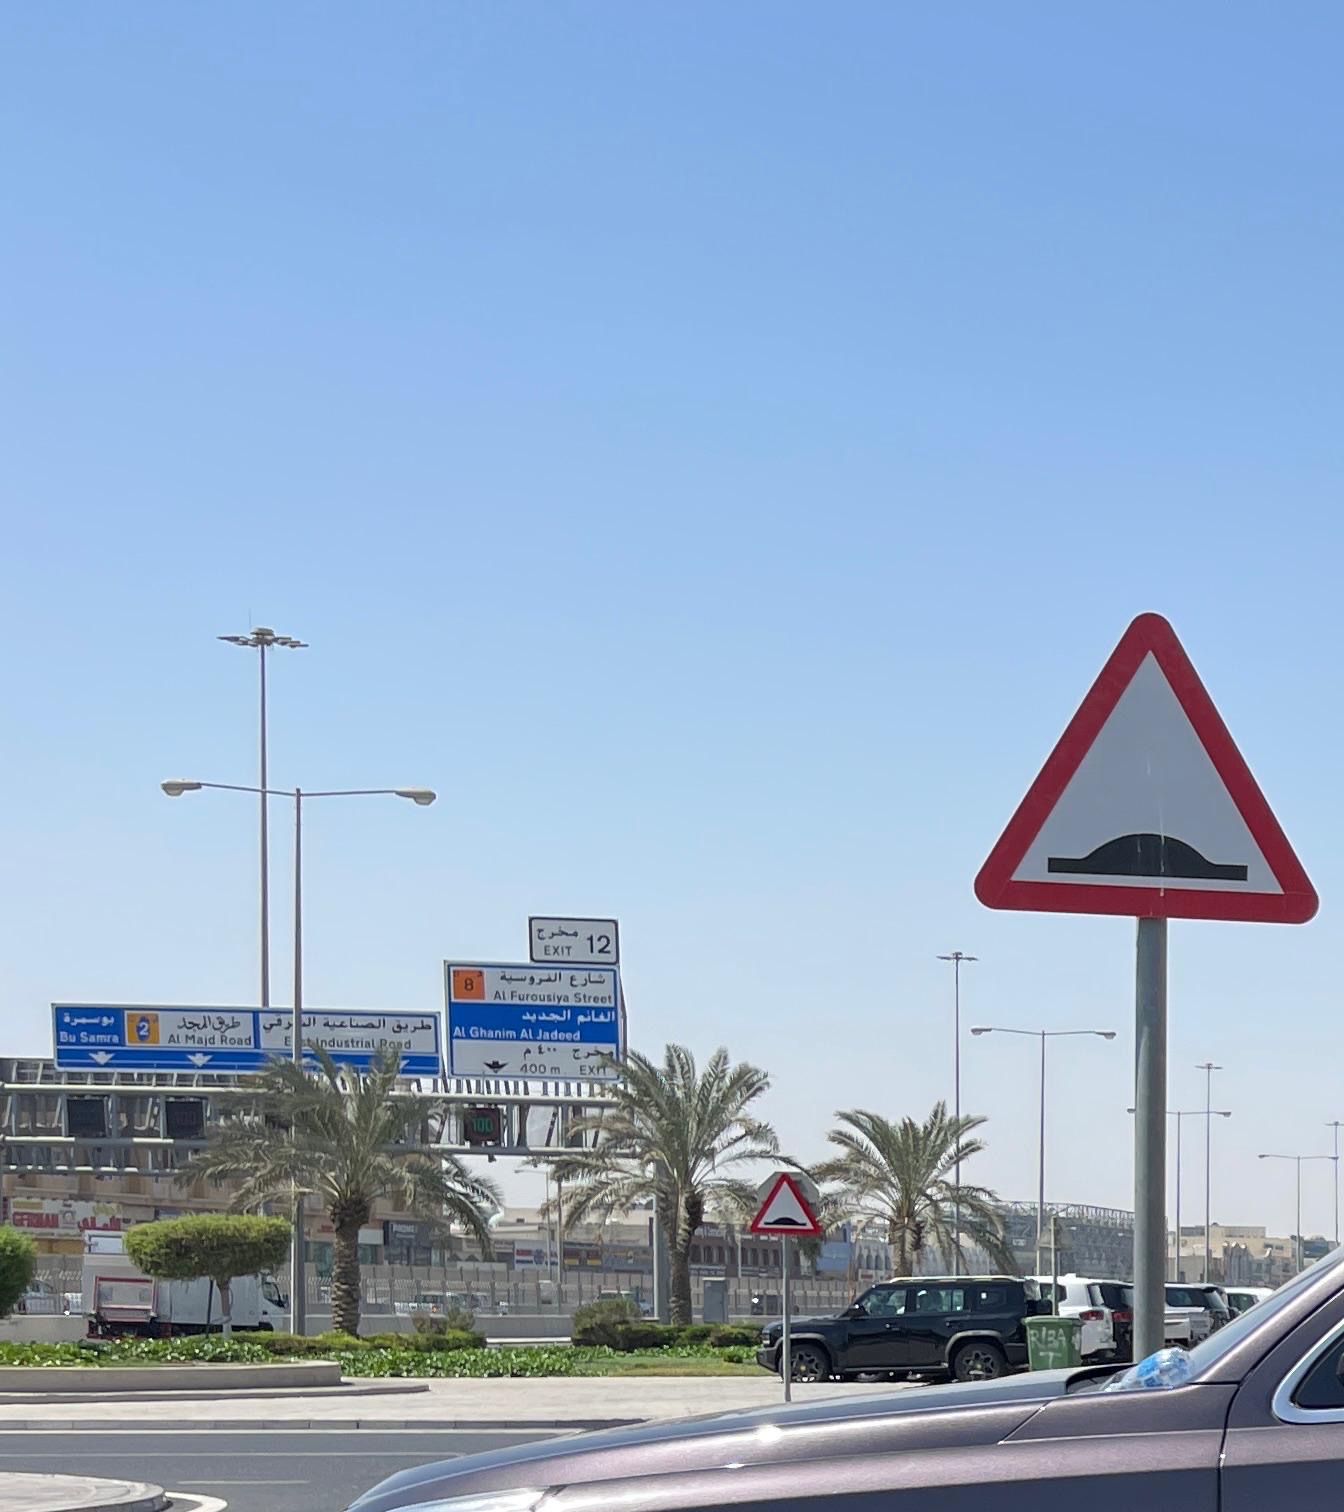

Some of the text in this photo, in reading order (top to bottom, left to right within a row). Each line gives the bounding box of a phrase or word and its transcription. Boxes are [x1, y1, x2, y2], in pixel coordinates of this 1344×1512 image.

[536, 926, 611, 954] مخرج 12
[544, 946, 572, 956] EXIT
[464, 978, 474, 991] 8
[493, 991, 612, 1004] Al Furousiya Street
[522, 1009, 571, 1024] الجديد
[138, 1021, 149, 1037] 2
[453, 1027, 581, 1041] Al Ghanim Al Jadeed
[60, 1032, 119, 1044] Bu Samra
[168, 1034, 251, 1047] Al Majd Road
[316, 1037, 375, 1049] Industrial
[520, 1064, 546, 1074] 400
[580, 1065, 607, 1076] EXIT
